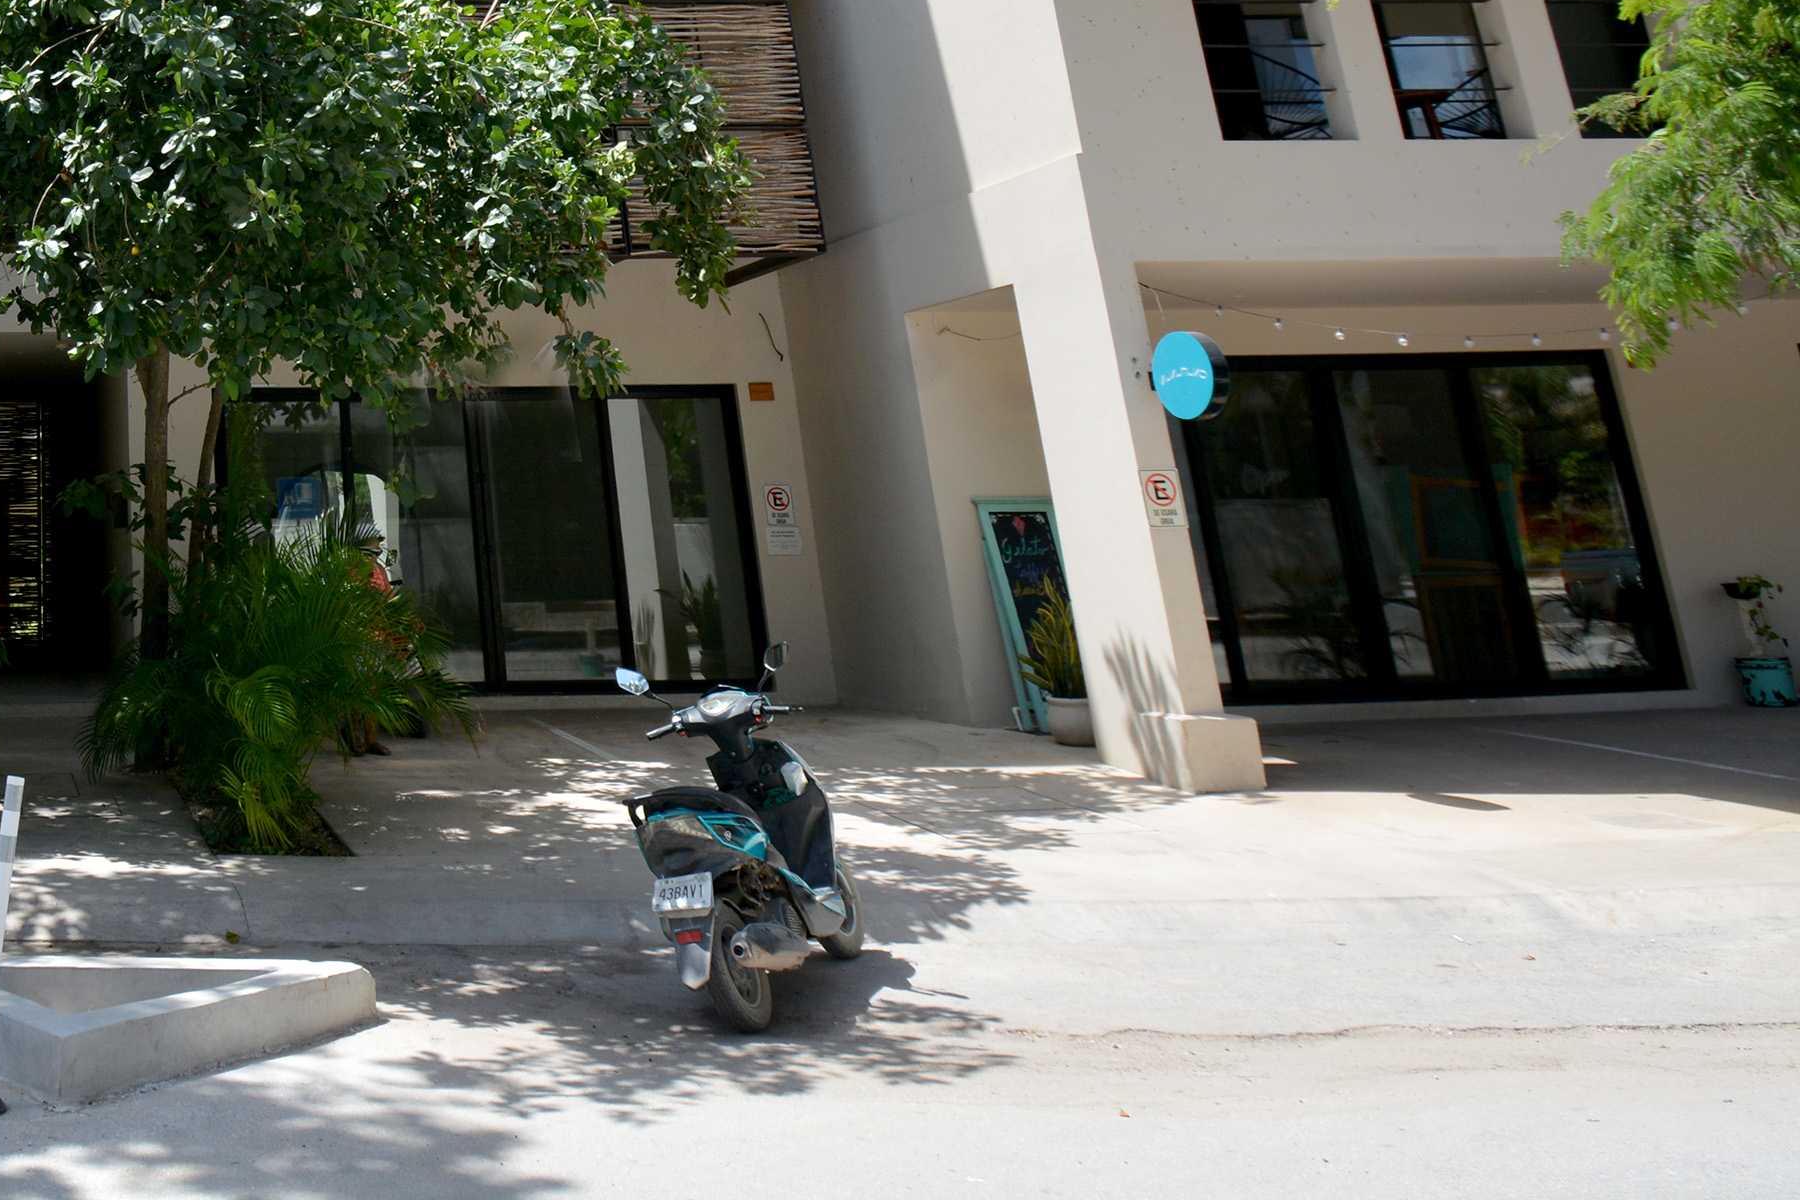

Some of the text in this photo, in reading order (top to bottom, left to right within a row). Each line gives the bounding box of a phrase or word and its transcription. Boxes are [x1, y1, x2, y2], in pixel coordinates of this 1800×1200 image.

[1152, 480, 1171, 500] E
[1153, 508, 1161, 517] SE
[659, 884, 702, 900] 43BAV1
